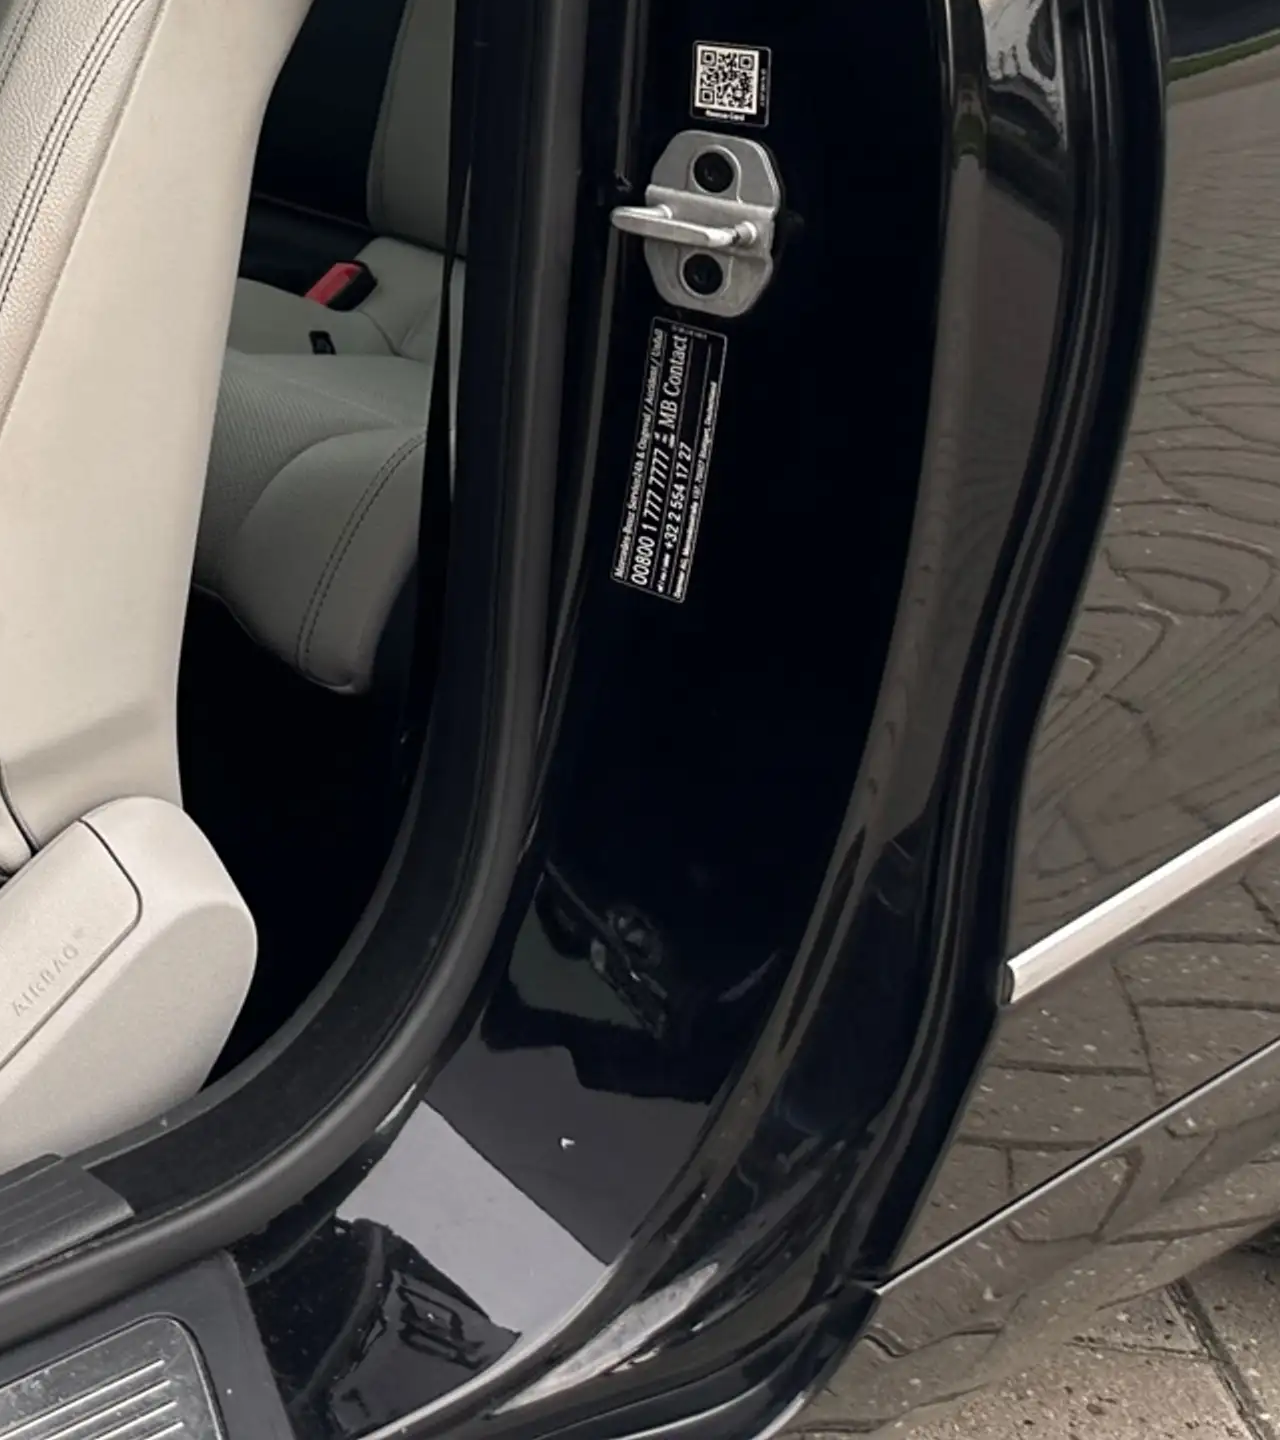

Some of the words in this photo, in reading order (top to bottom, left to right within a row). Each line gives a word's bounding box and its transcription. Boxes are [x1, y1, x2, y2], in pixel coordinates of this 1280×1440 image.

[661, 332, 690, 399] Contact
[656, 397, 679, 430] MB
[676, 440, 693, 462] 27
[647, 446, 671, 489] 7777
[673, 463, 690, 480] 17
[642, 488, 664, 522] 777
[668, 481, 686, 511] 554
[639, 521, 658, 533] 1
[666, 510, 682, 523] 2
[661, 522, 680, 552] +32
[629, 532, 656, 587] 00800
